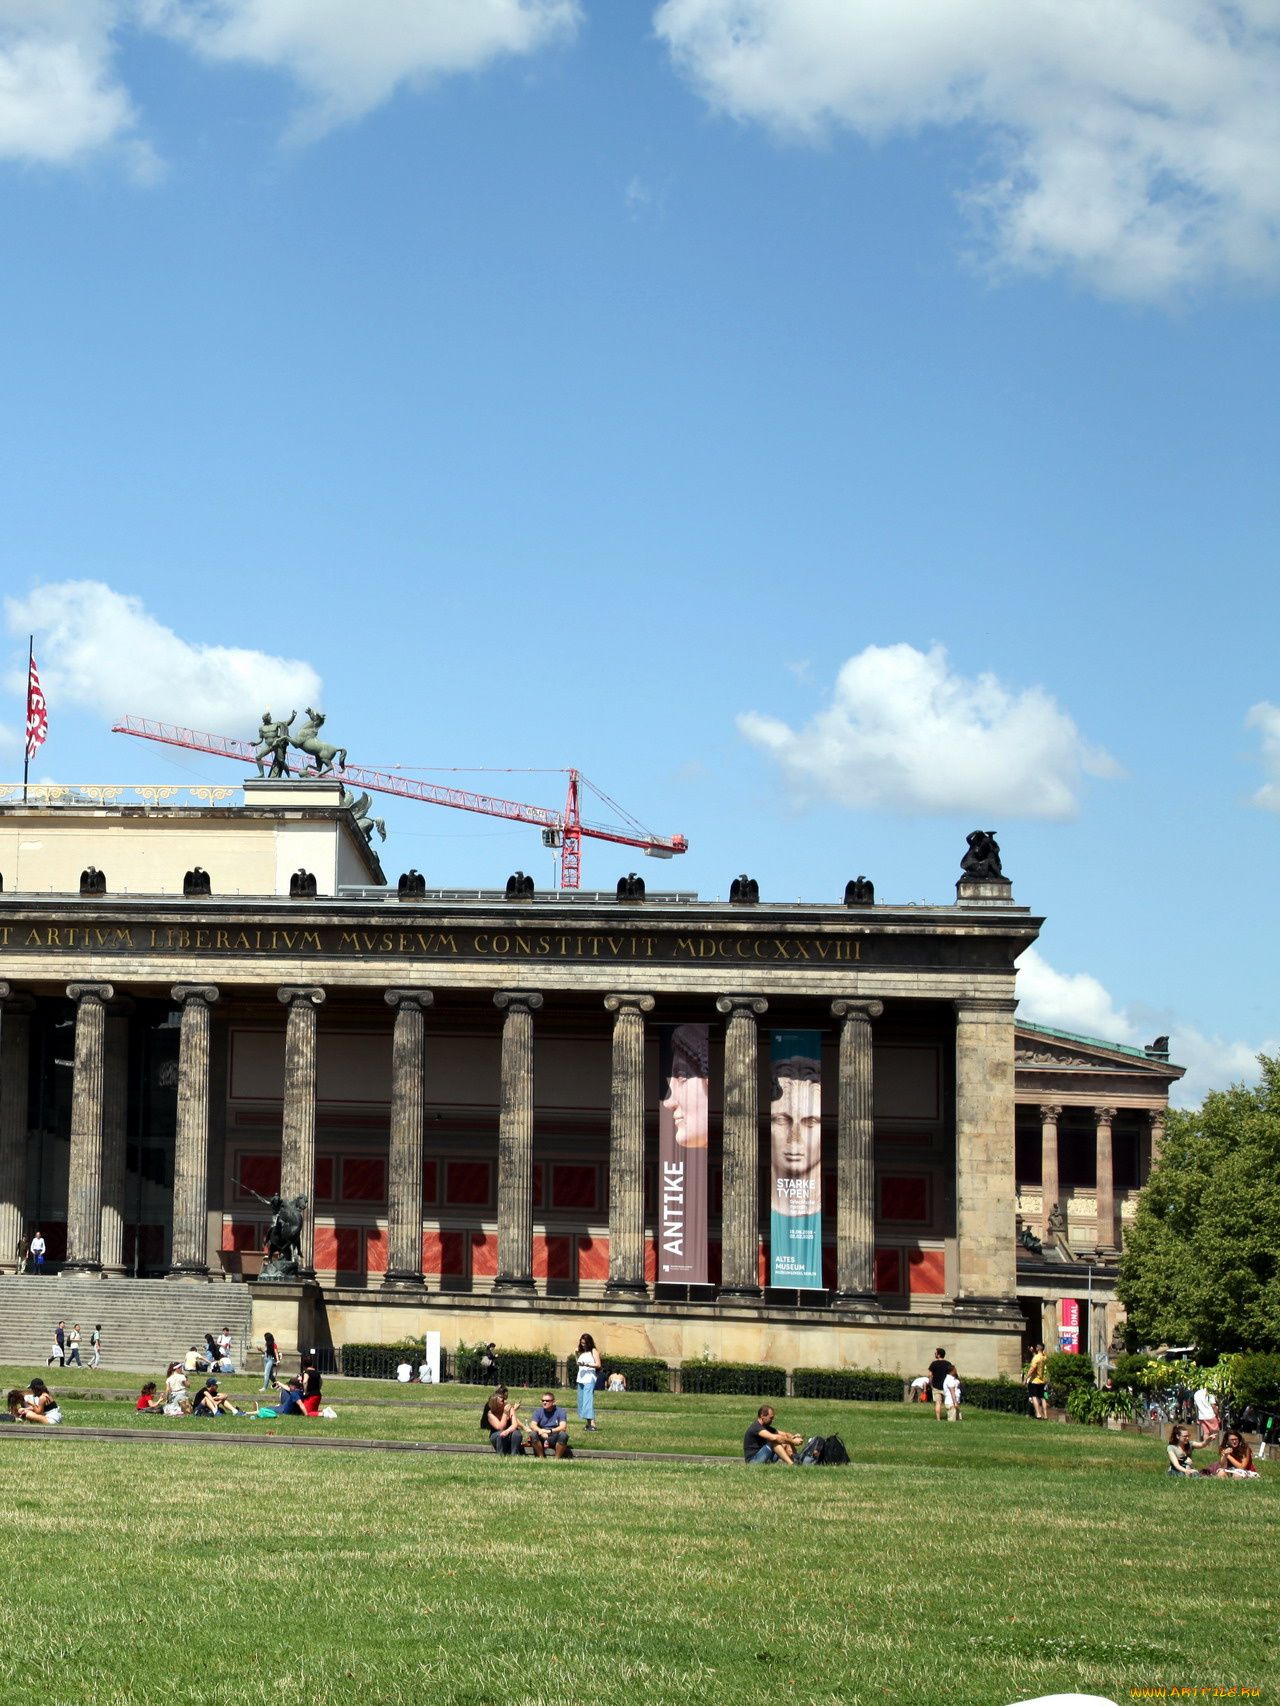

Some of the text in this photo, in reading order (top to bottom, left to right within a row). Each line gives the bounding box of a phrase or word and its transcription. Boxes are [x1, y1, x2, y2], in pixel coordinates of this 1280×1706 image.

[24, 927, 135, 948] ARTIVM
[149, 929, 323, 951] LIBERALIVM
[338, 932, 458, 953] MVSEVM
[474, 935, 658, 957] CONSTITVIT
[672, 938, 862, 960] MDCCCXXVIII
[776, 1178, 816, 1189] STARKE
[776, 1188, 810, 1199] TYPEN
[663, 1161, 684, 1257] ANTIKE
[775, 1255, 795, 1263] ALTES
[775, 1263, 805, 1271] MUSEUM
